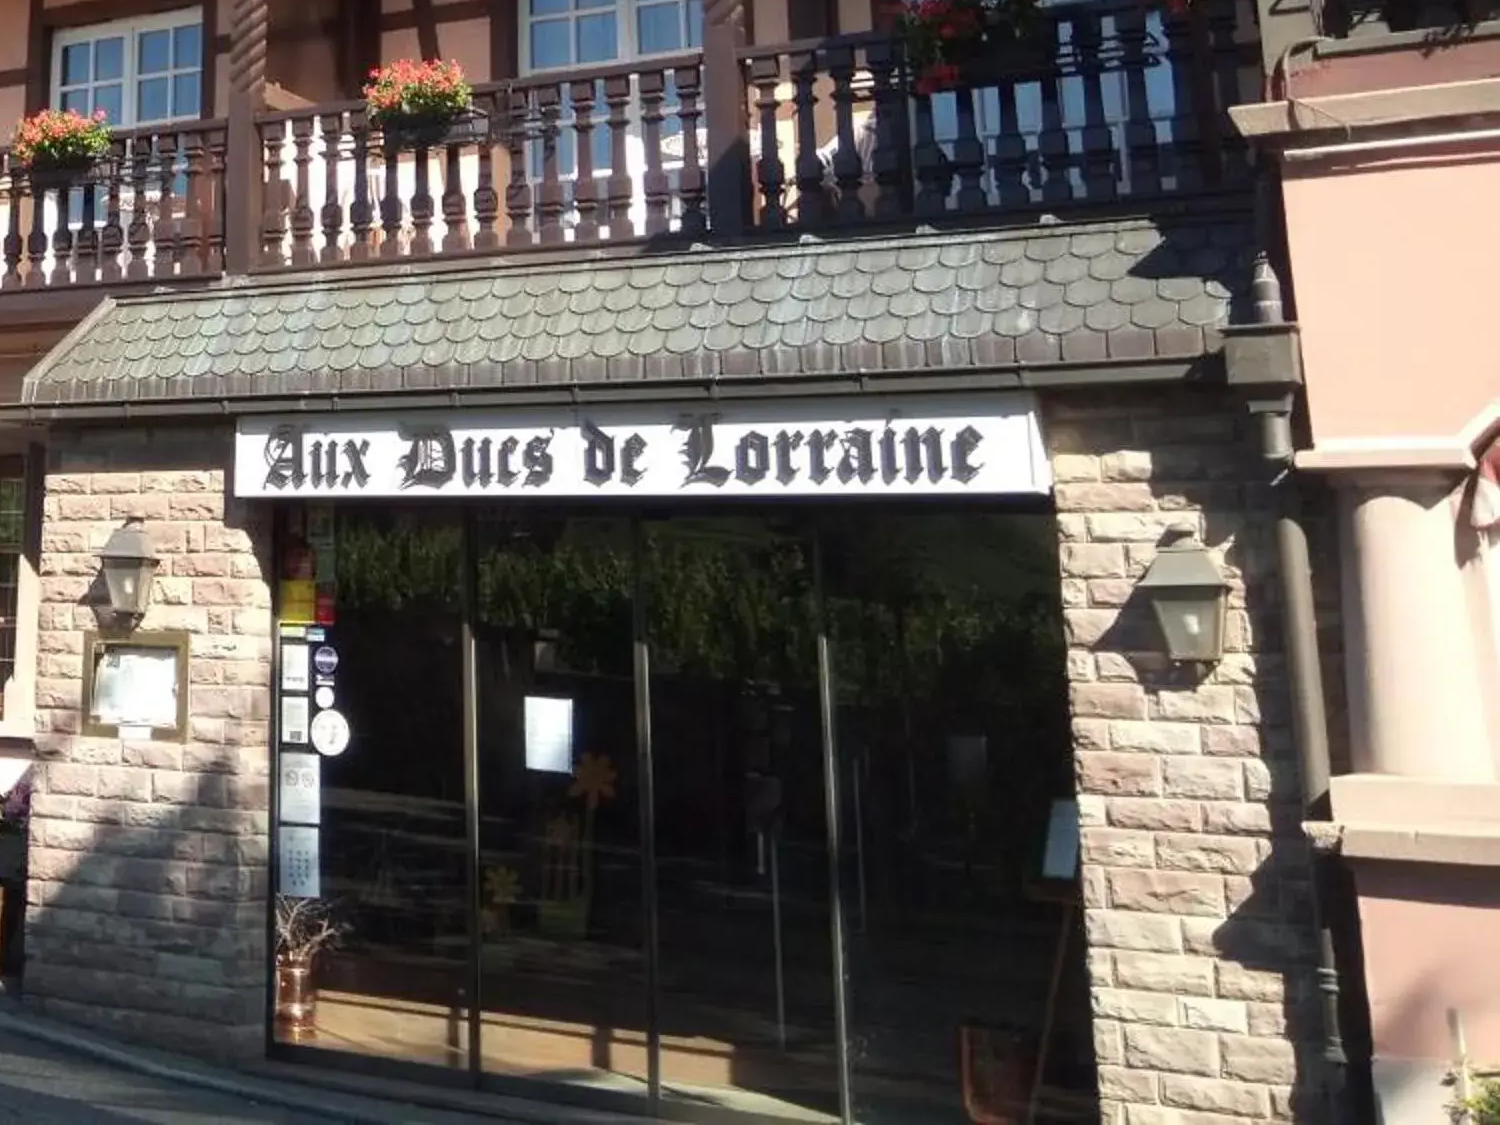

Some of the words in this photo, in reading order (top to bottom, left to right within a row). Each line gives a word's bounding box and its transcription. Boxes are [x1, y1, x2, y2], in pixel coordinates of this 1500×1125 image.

[263, 423, 370, 491] Aux
[397, 423, 555, 490] Ducs
[580, 417, 648, 487] de
[671, 412, 985, 488] Lorraine
